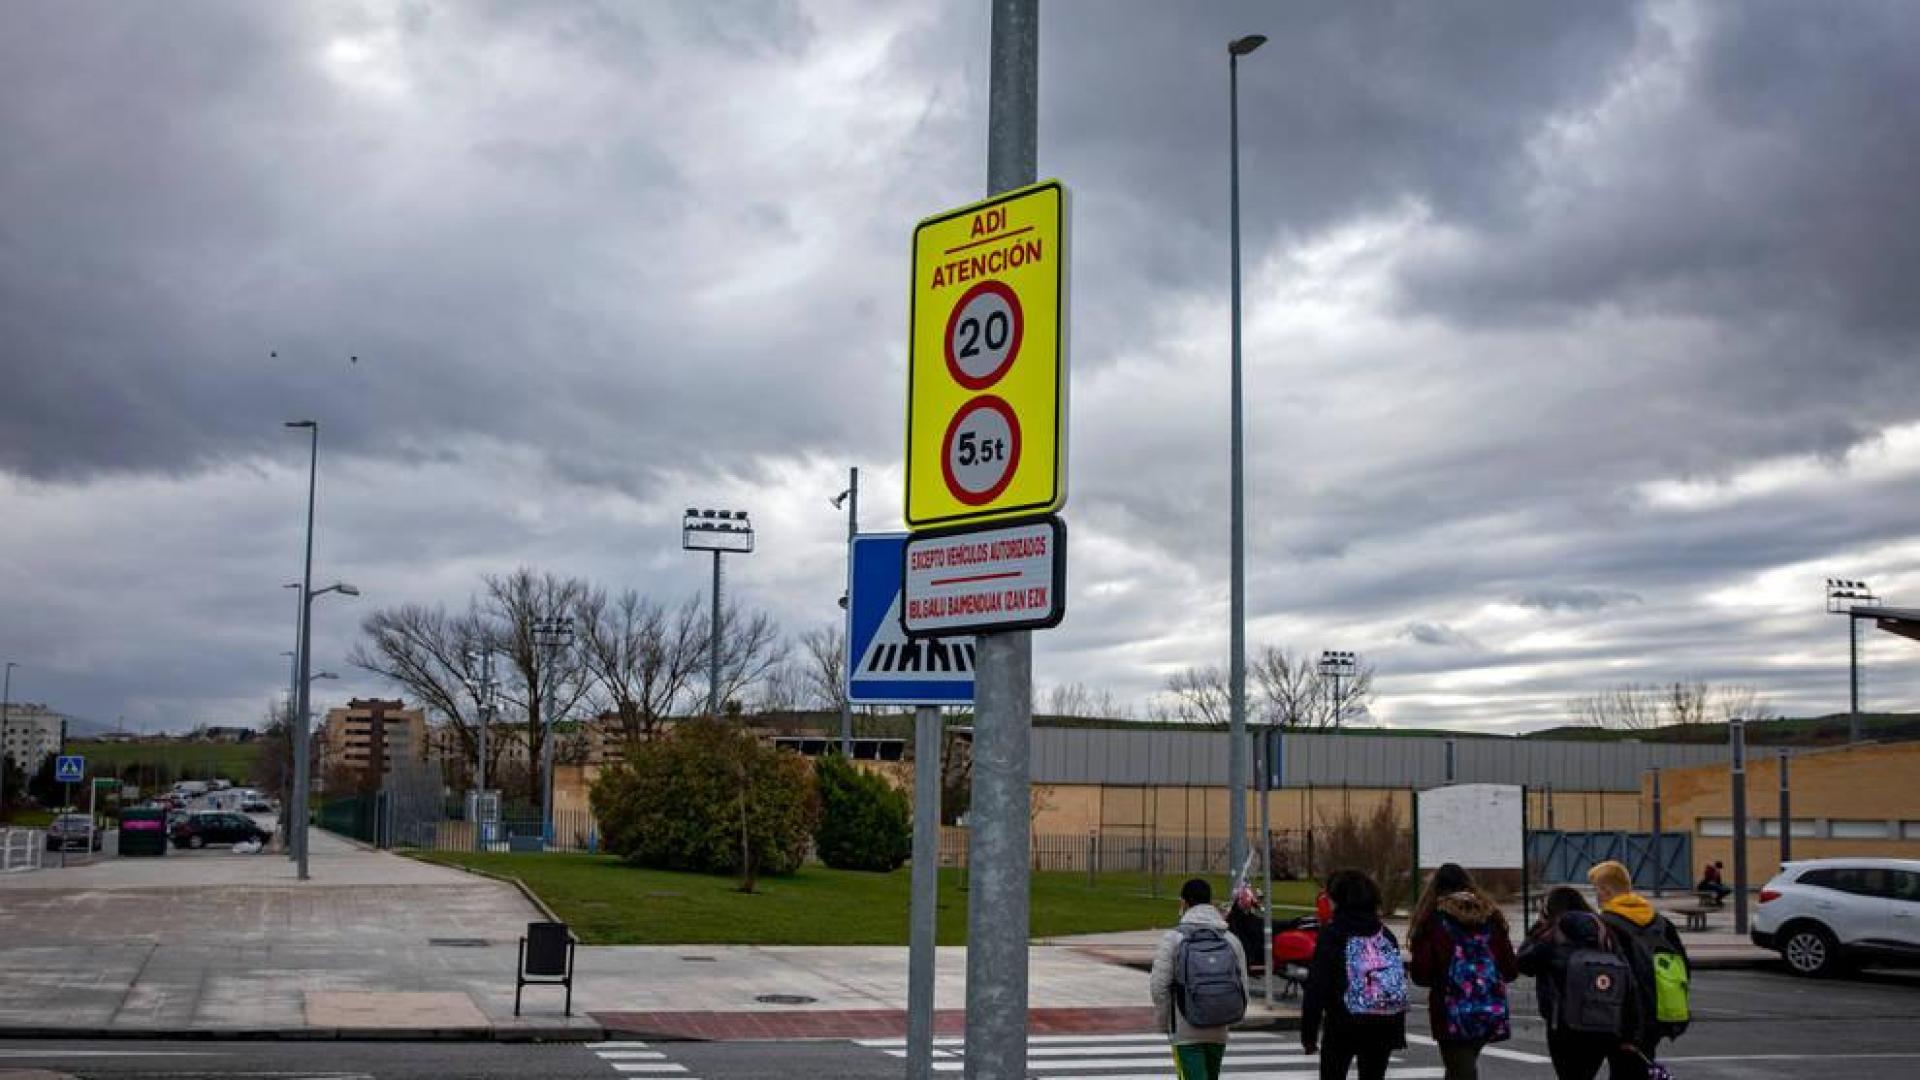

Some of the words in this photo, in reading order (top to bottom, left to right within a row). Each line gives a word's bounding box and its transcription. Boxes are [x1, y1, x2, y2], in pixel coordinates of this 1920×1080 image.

[971, 207, 1006, 239] ADI
[931, 238, 1042, 290] ATENCIÓN
[959, 310, 1009, 360] 20
[911, 548, 944, 571] EXCEPTO
[990, 536, 1046, 560] AUTORIZADOS
